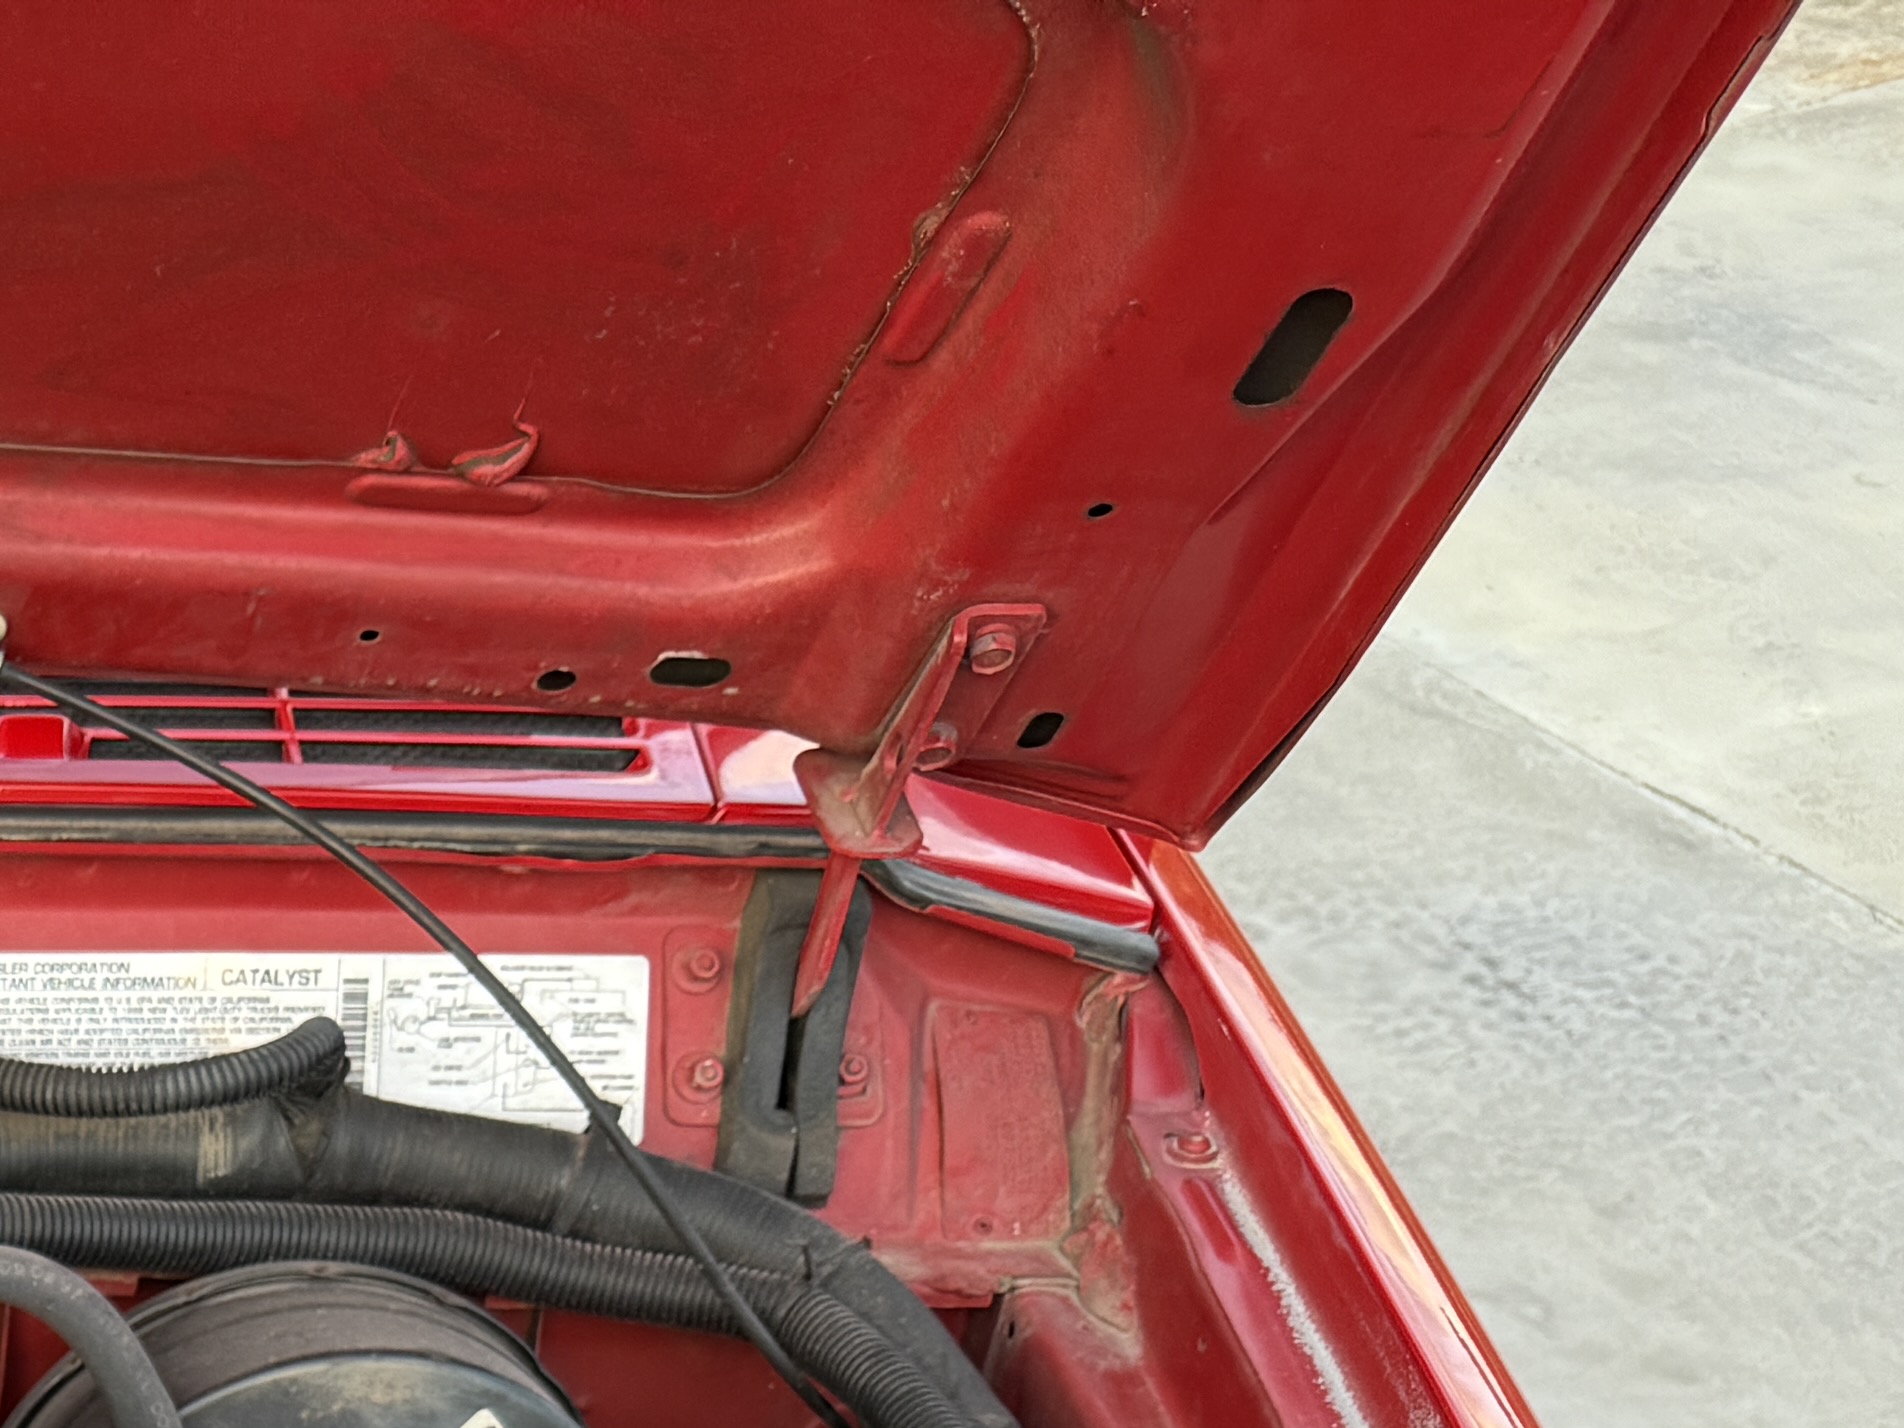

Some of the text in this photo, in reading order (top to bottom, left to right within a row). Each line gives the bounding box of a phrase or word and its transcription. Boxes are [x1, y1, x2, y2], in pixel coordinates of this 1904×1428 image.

[34, 962, 130, 974] CORPORATION
[42, 976, 97, 990] VEHICLE
[102, 976, 196, 990] INFORMATION
[221, 969, 322, 986] CATALYST
